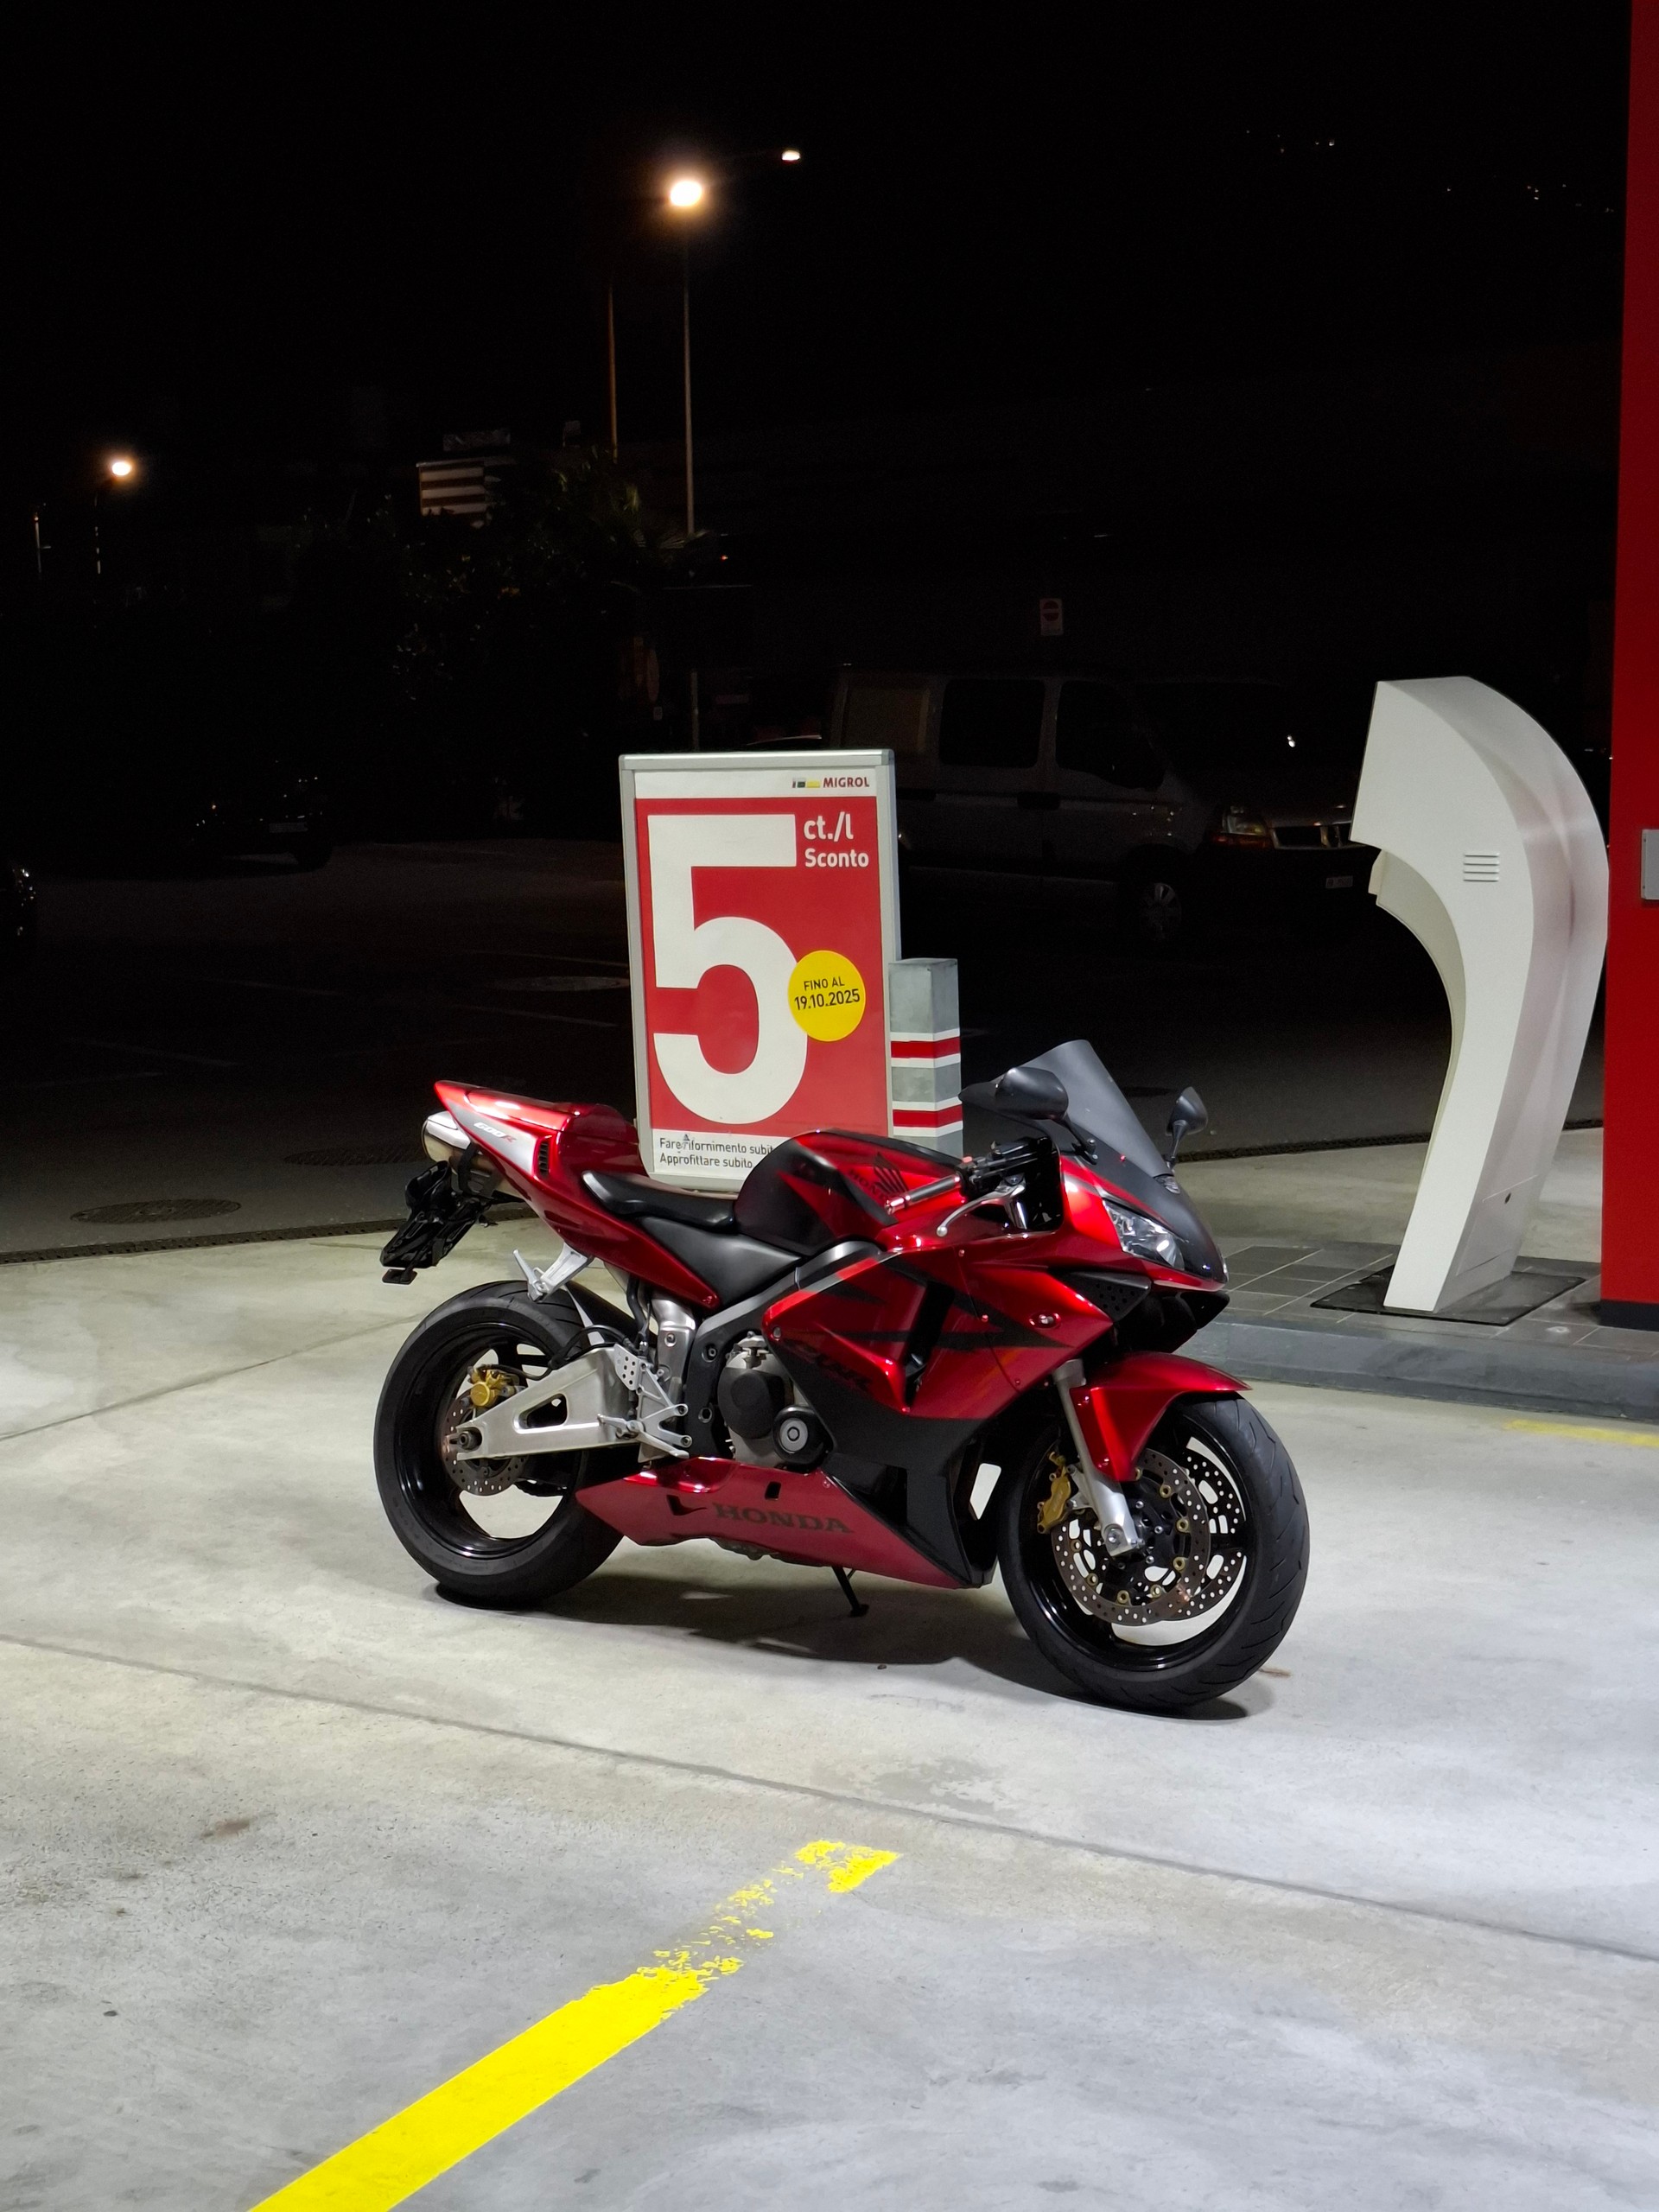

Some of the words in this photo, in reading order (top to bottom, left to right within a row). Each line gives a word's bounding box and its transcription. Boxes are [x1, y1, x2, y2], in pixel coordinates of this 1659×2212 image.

[823, 777, 870, 789] MIGROL
[804, 810, 854, 842] ct./l
[804, 848, 869, 868] Sconto
[647, 813, 808, 1125] 5
[804, 978, 829, 991] FINO
[831, 976, 845, 988] AL
[794, 988, 861, 1011] 19.10.2025
[659, 1137, 681, 1150] Fare
[749, 1143, 775, 1155] subit
[659, 1152, 720, 1166] Approfittare
[722, 1157, 753, 1169] subito
[712, 1503, 855, 1535] HONDA
